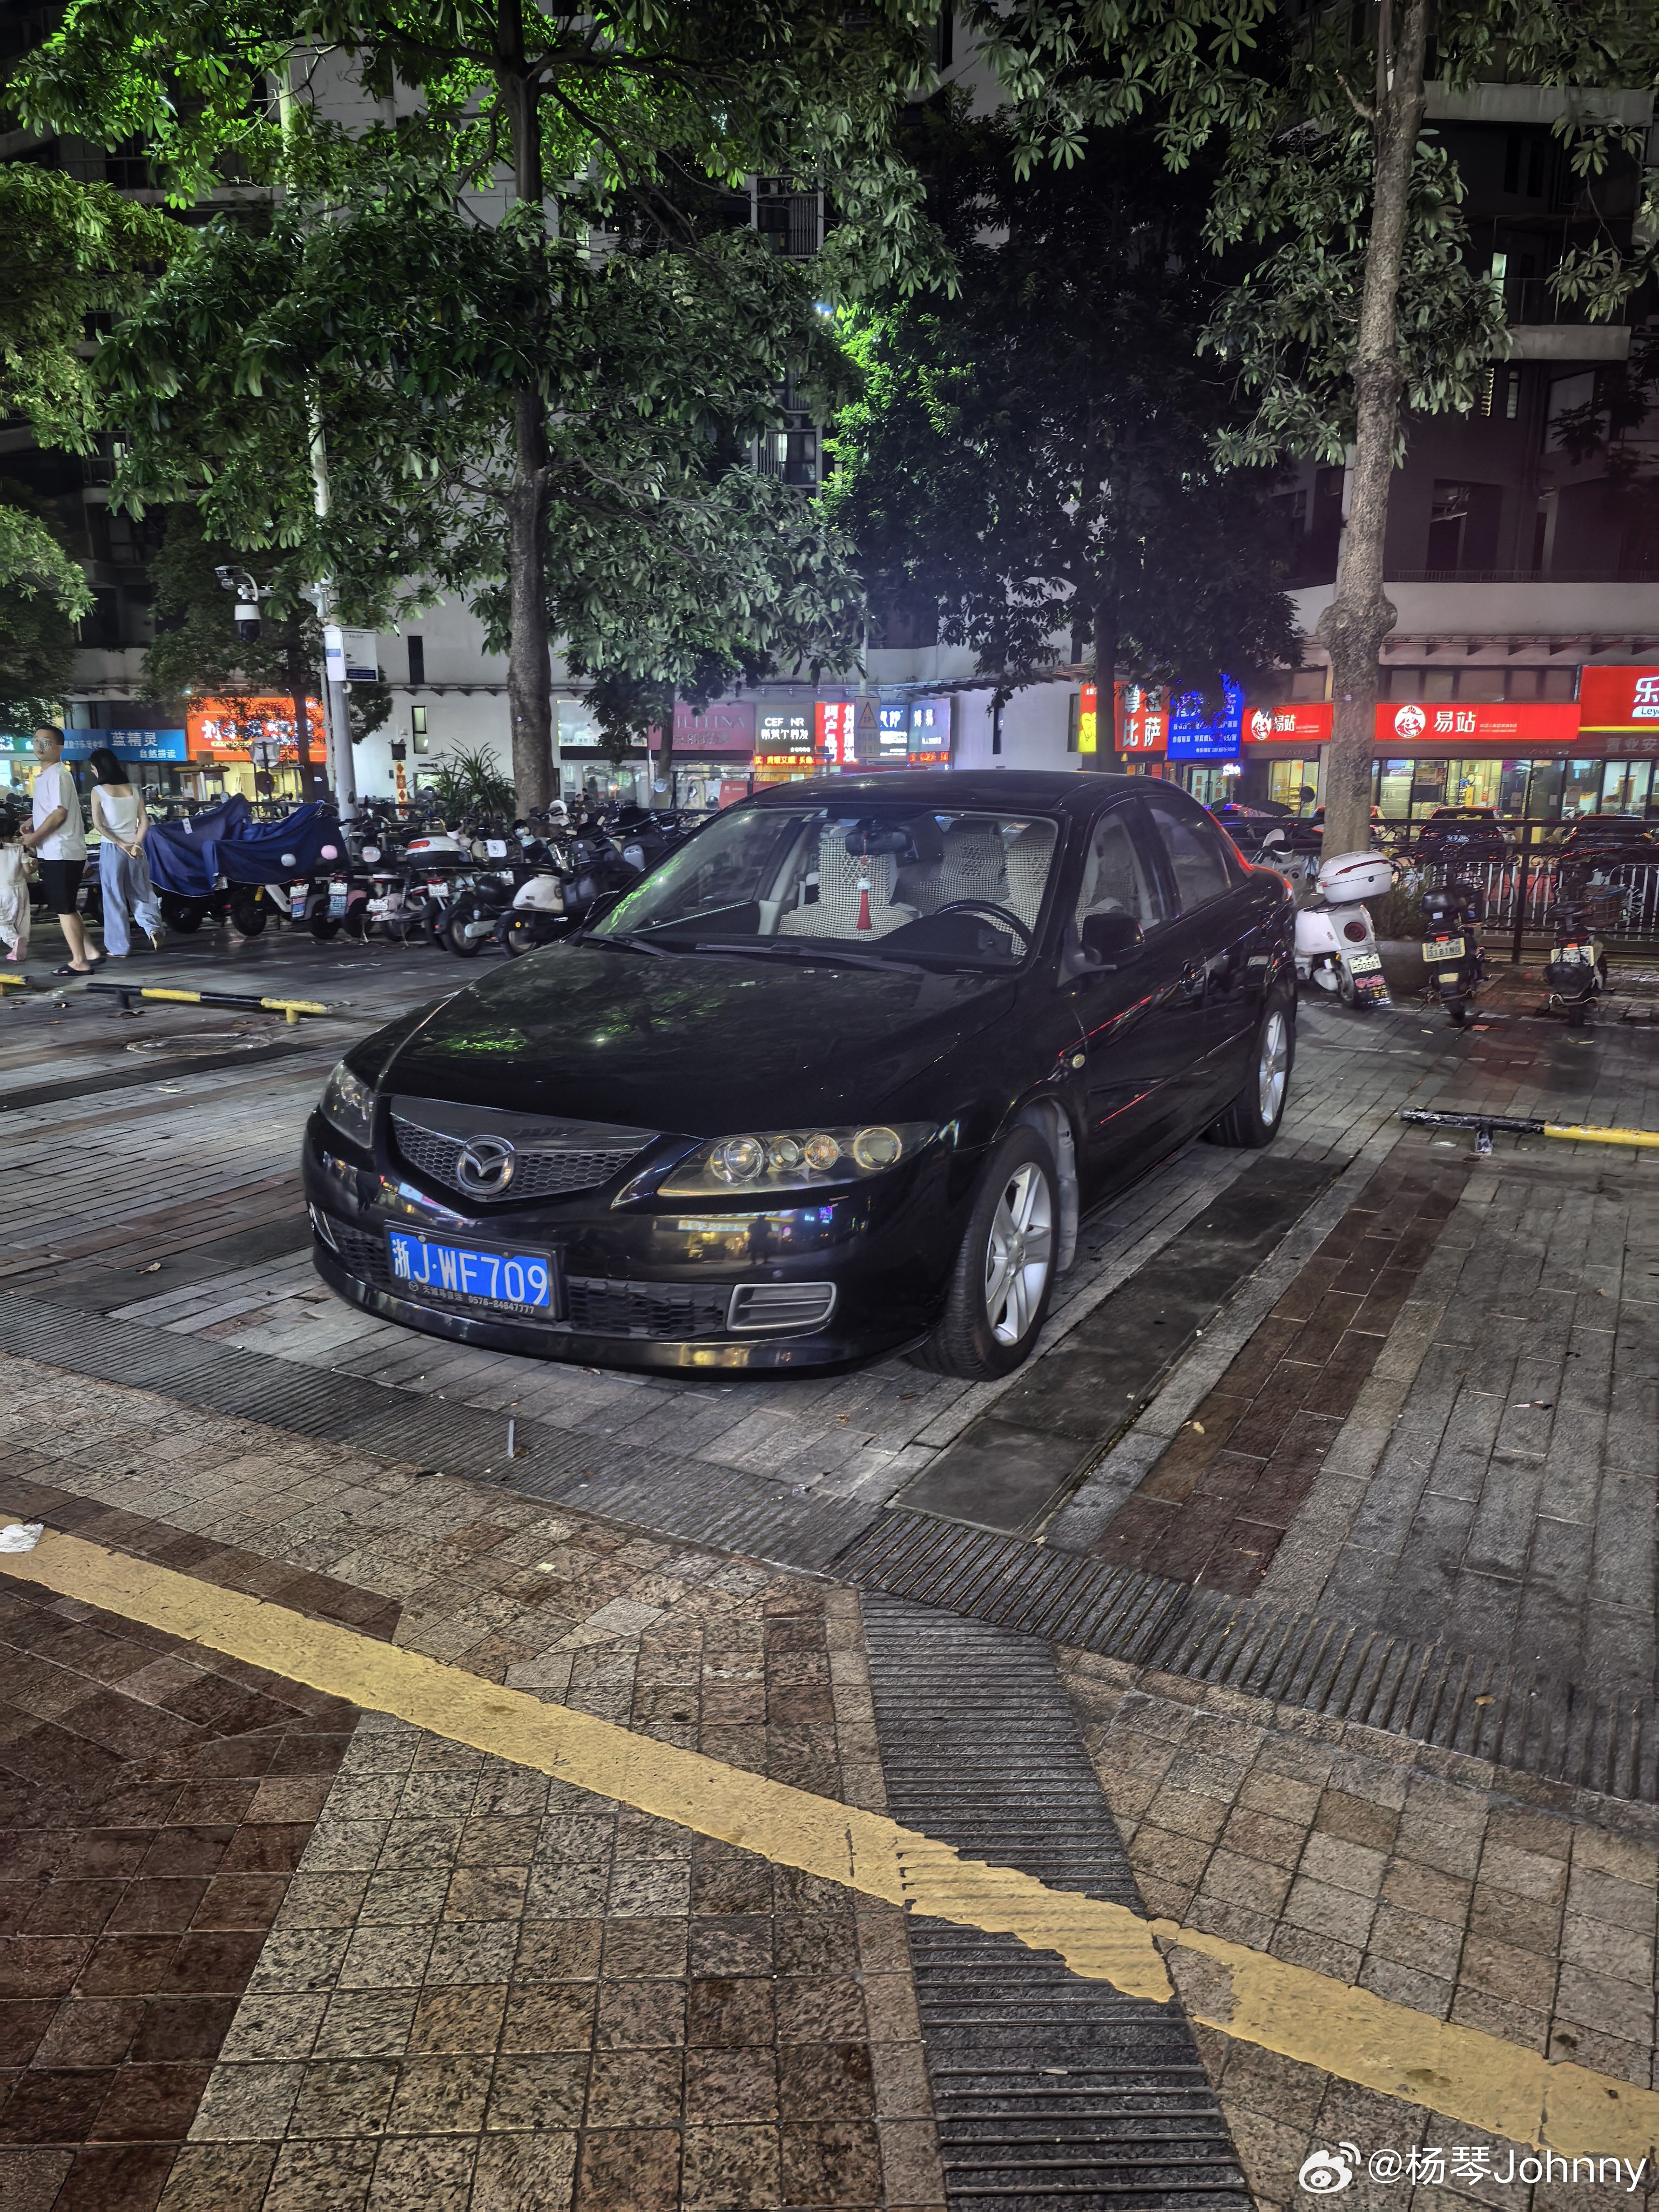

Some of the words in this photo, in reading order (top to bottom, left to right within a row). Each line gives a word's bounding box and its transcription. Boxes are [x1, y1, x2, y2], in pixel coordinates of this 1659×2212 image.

[1122, 716, 1162, 747] 比萨
[1434, 711, 1476, 733] 易站
[392, 1238, 548, 1306] 浙J·WF709
